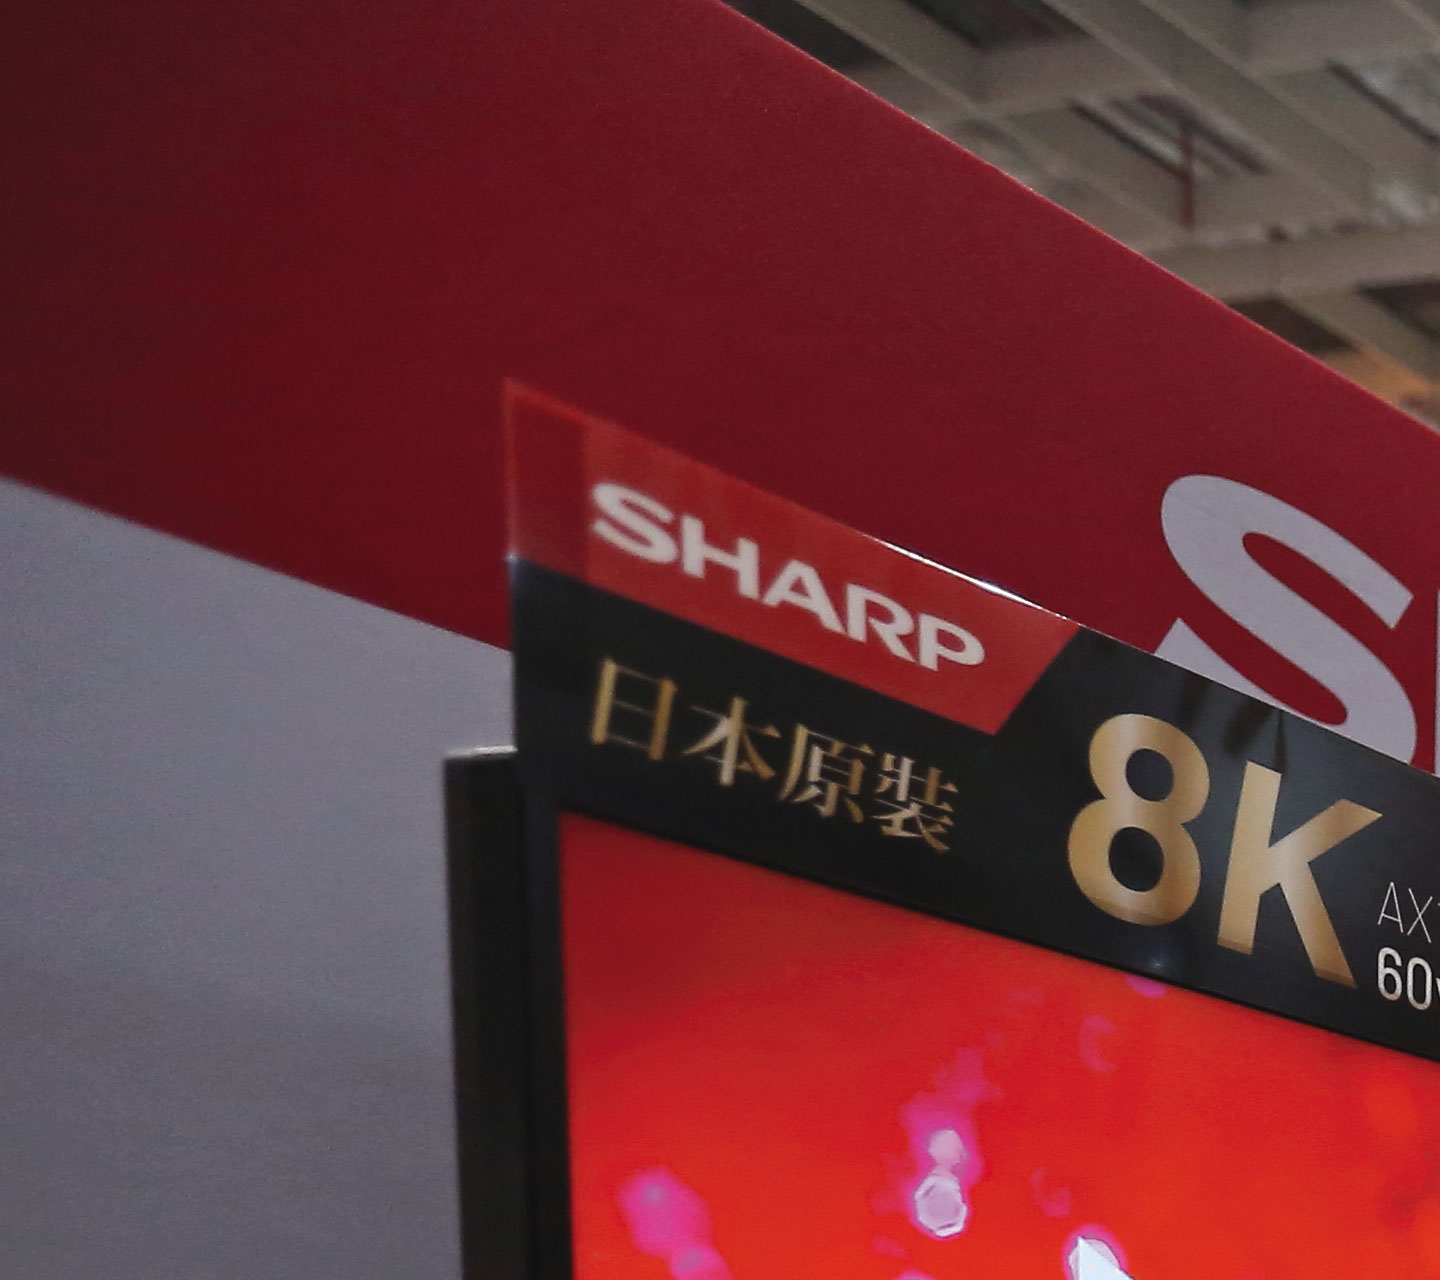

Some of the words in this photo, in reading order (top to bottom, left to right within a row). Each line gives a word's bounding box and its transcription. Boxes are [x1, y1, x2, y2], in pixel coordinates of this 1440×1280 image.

[590, 482, 986, 672] SHARP
[590, 657, 959, 854] 日本原裝
[1067, 713, 1382, 989] 8K
